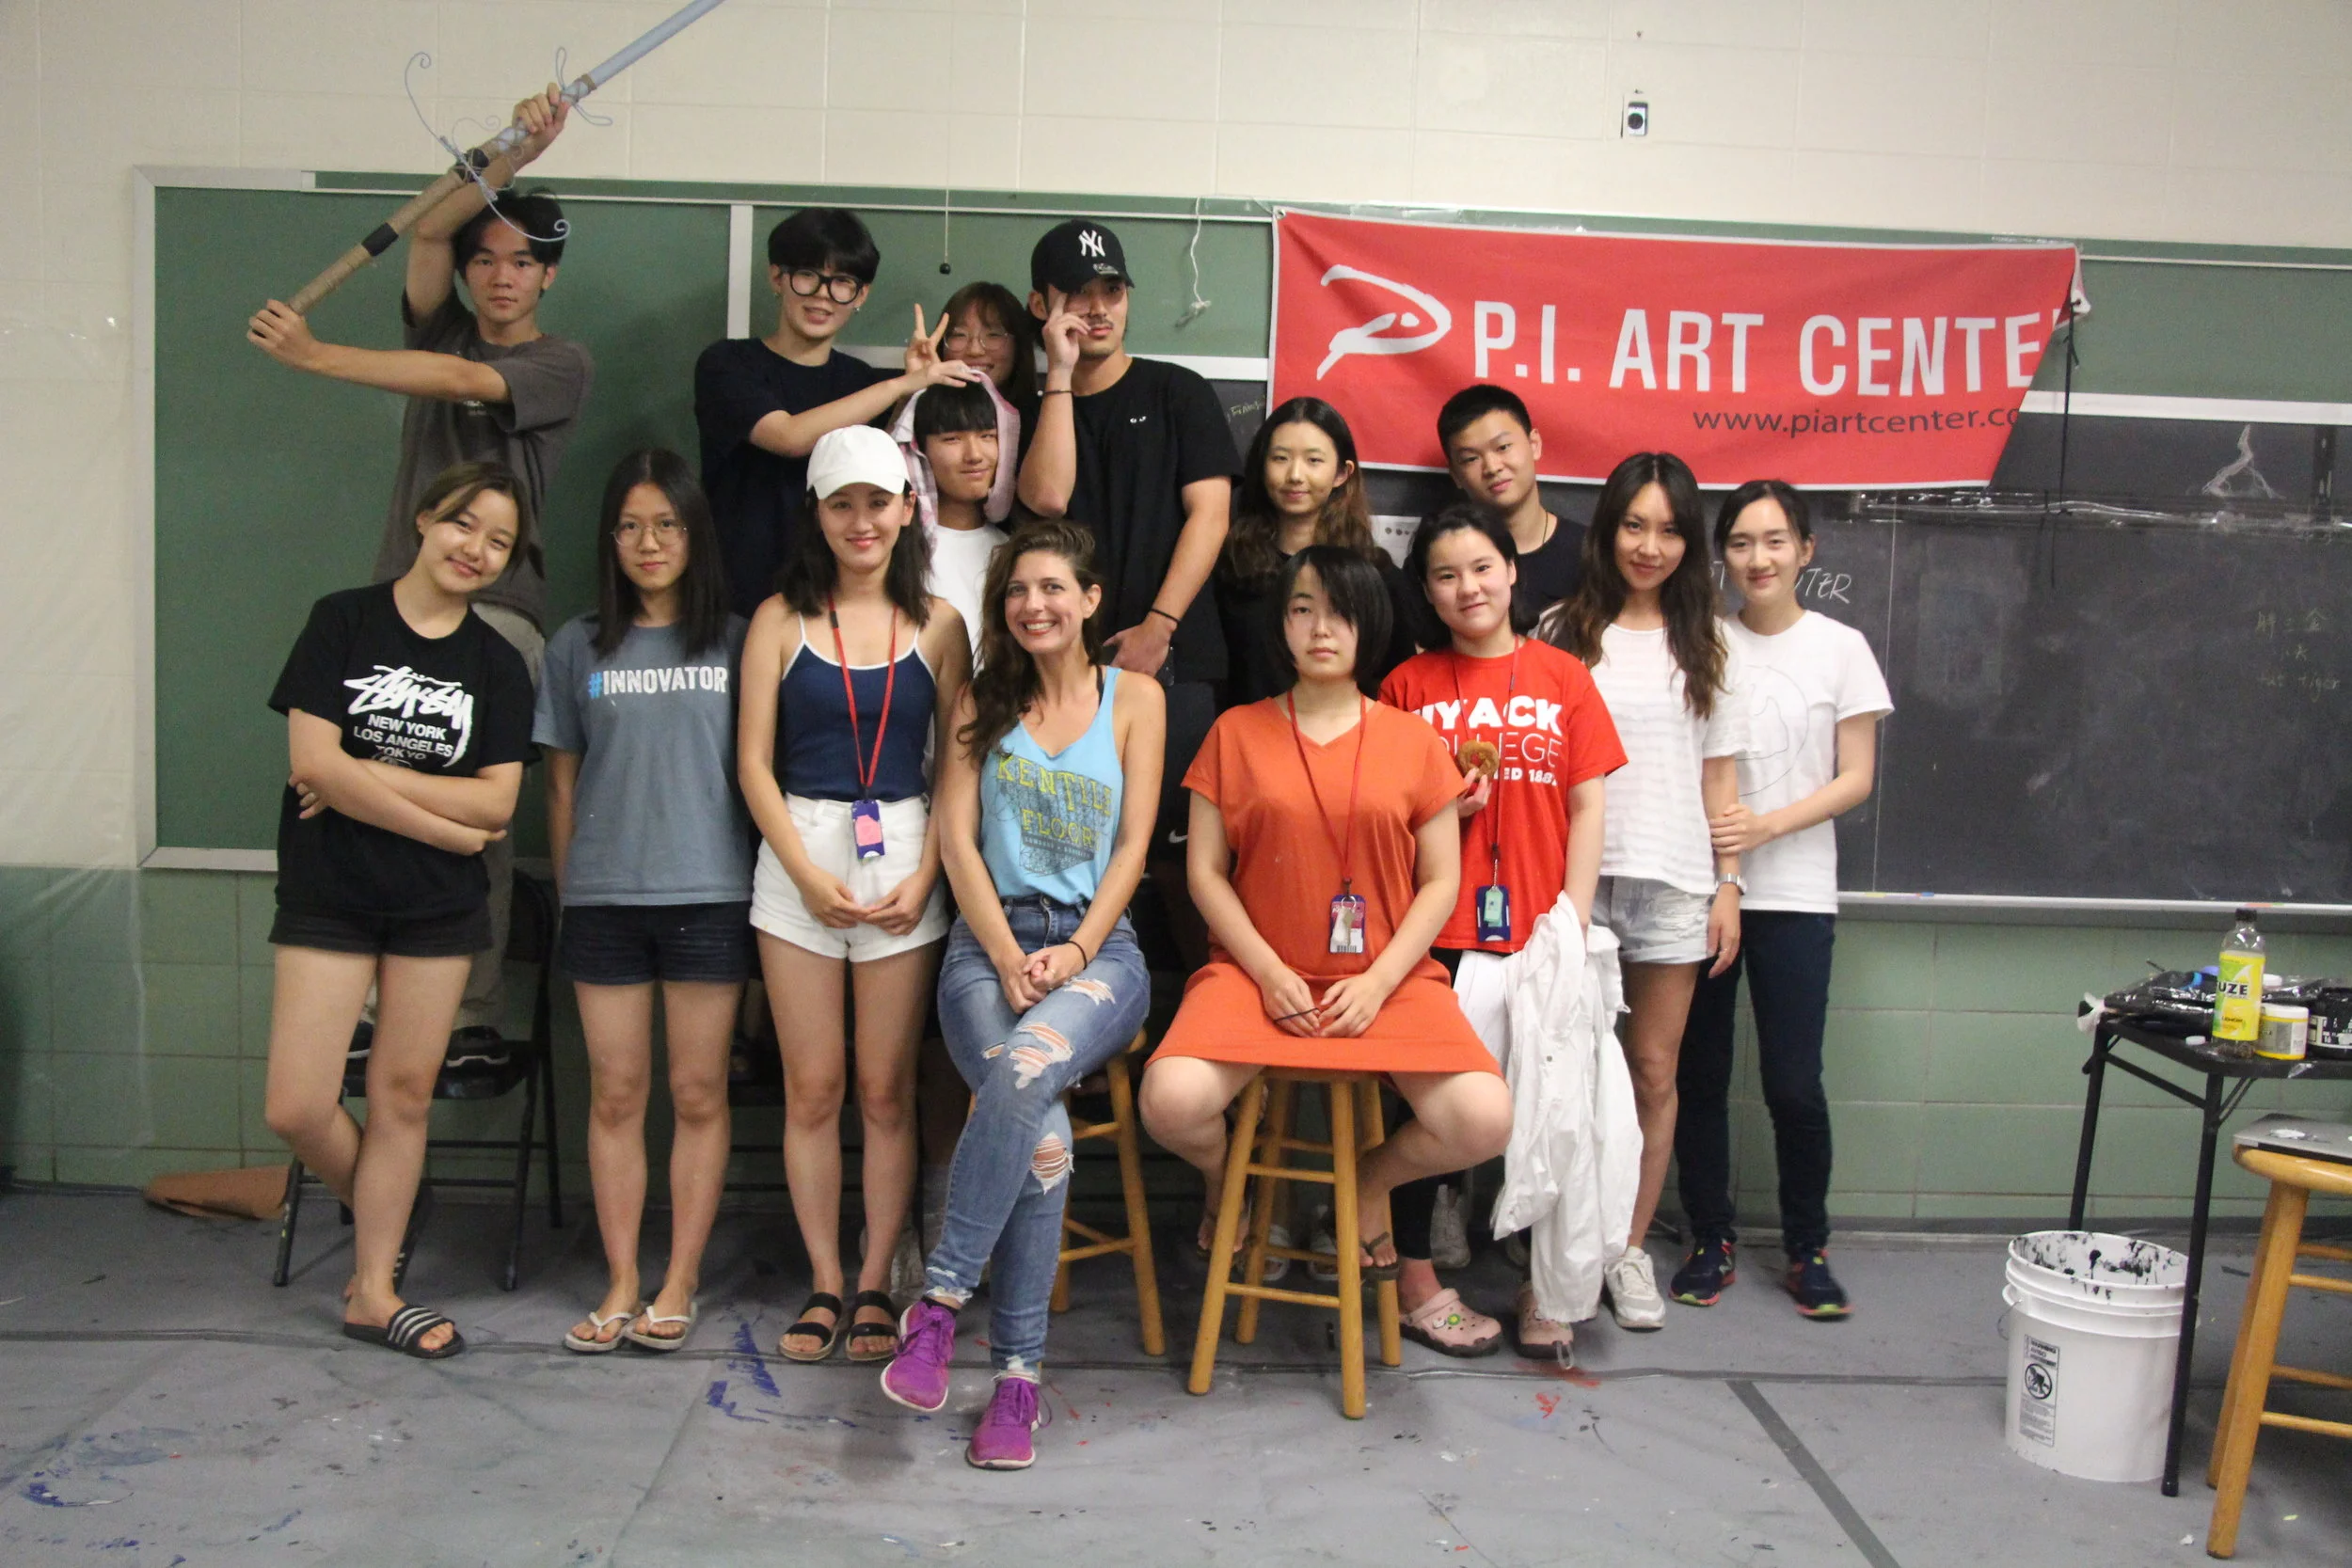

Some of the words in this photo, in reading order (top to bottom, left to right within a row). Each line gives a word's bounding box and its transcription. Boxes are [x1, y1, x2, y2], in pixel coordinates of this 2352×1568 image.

[1474, 300, 1581, 384] P.I.
[1609, 309, 1764, 392] ART
[1799, 309, 2060, 396] CENTE
[588, 666, 727, 698] #INNOVATOR
[354, 726, 384, 743] LOS
[385, 735, 454, 757] ANGELES
[368, 713, 405, 733] NEW
[406, 721, 447, 740] YORK
[376, 744, 427, 760] TOKYO
